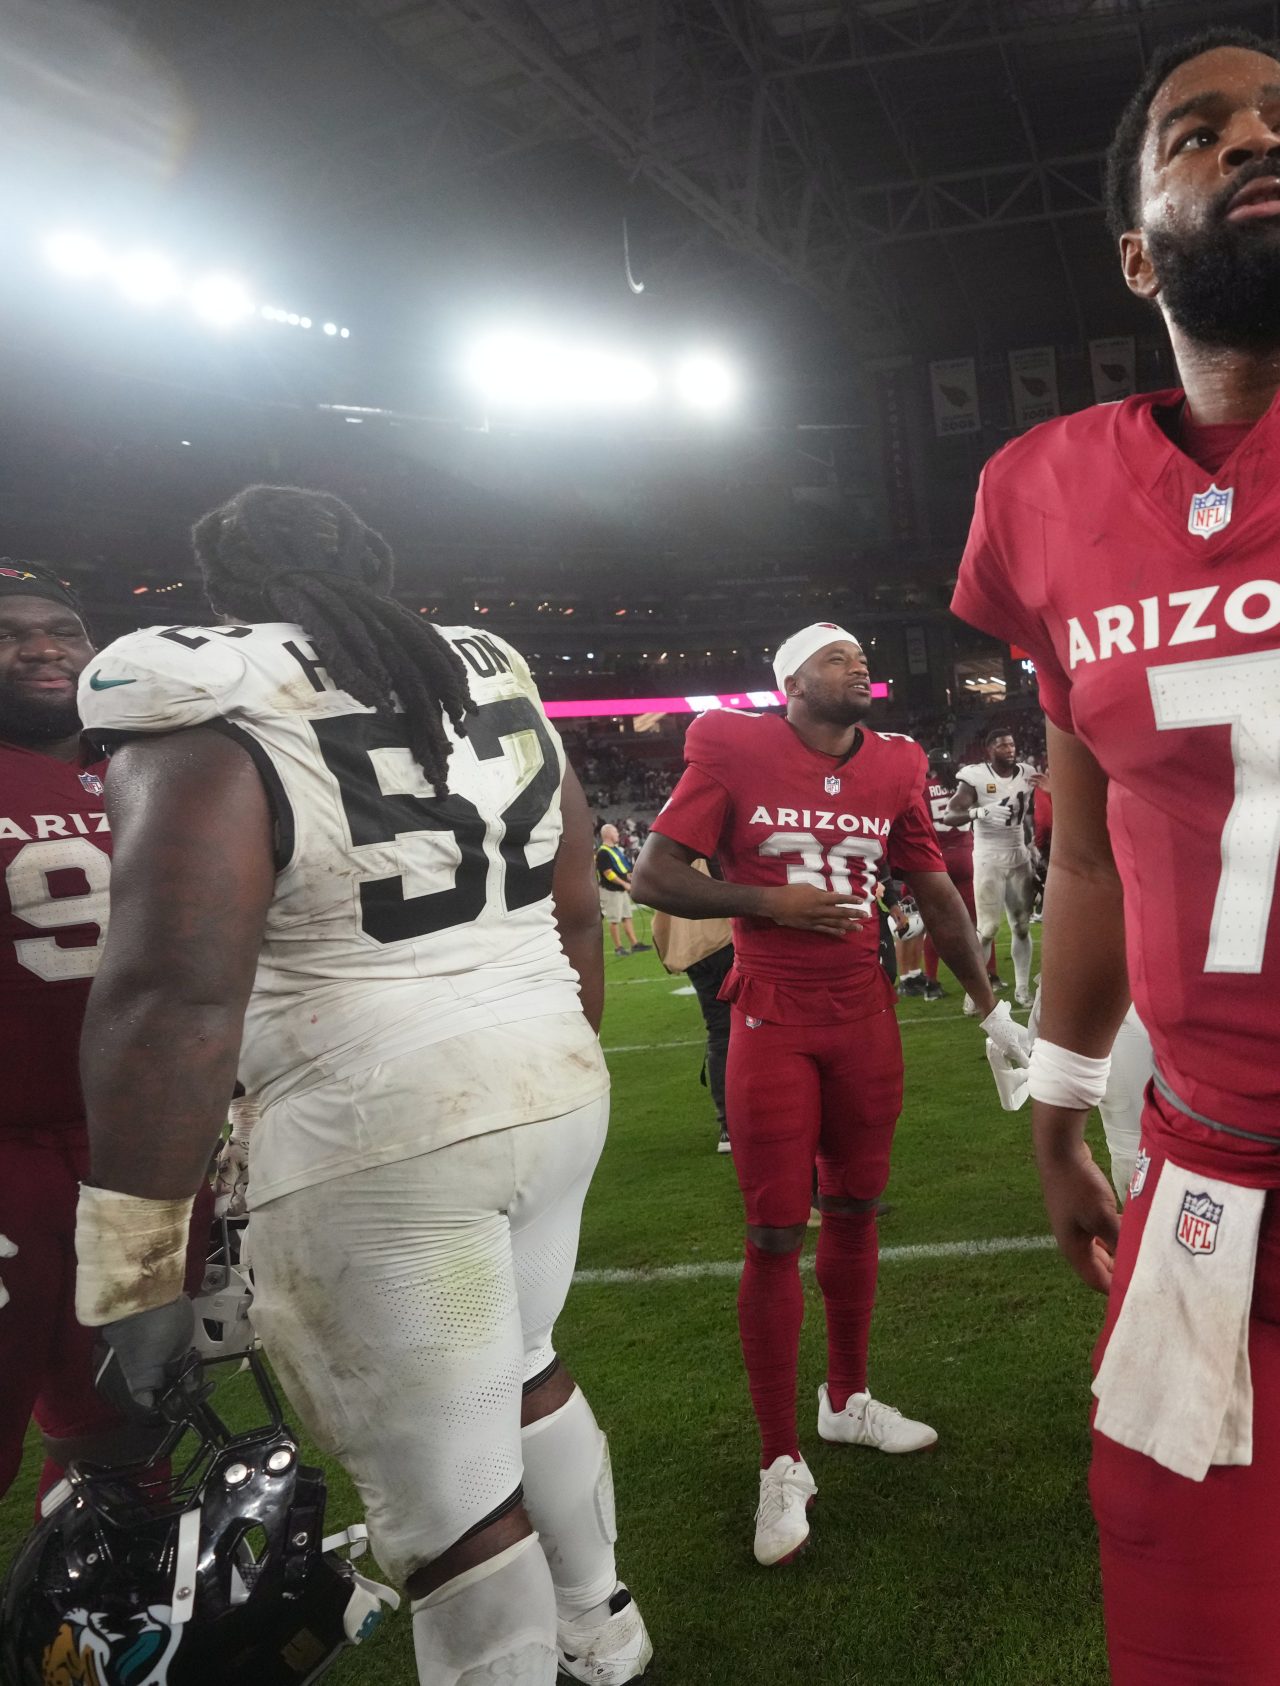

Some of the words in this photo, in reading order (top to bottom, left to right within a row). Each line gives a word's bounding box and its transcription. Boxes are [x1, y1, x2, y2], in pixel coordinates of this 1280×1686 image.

[1195, 507, 1223, 528] NFL
[1021, 659, 1037, 674] 4:
[0, 812, 111, 841] ARIZ
[306, 695, 565, 946] 52
[749, 805, 892, 837] ARIZONA
[758, 831, 885, 919] 30
[1179, 1213, 1211, 1250] NFL
